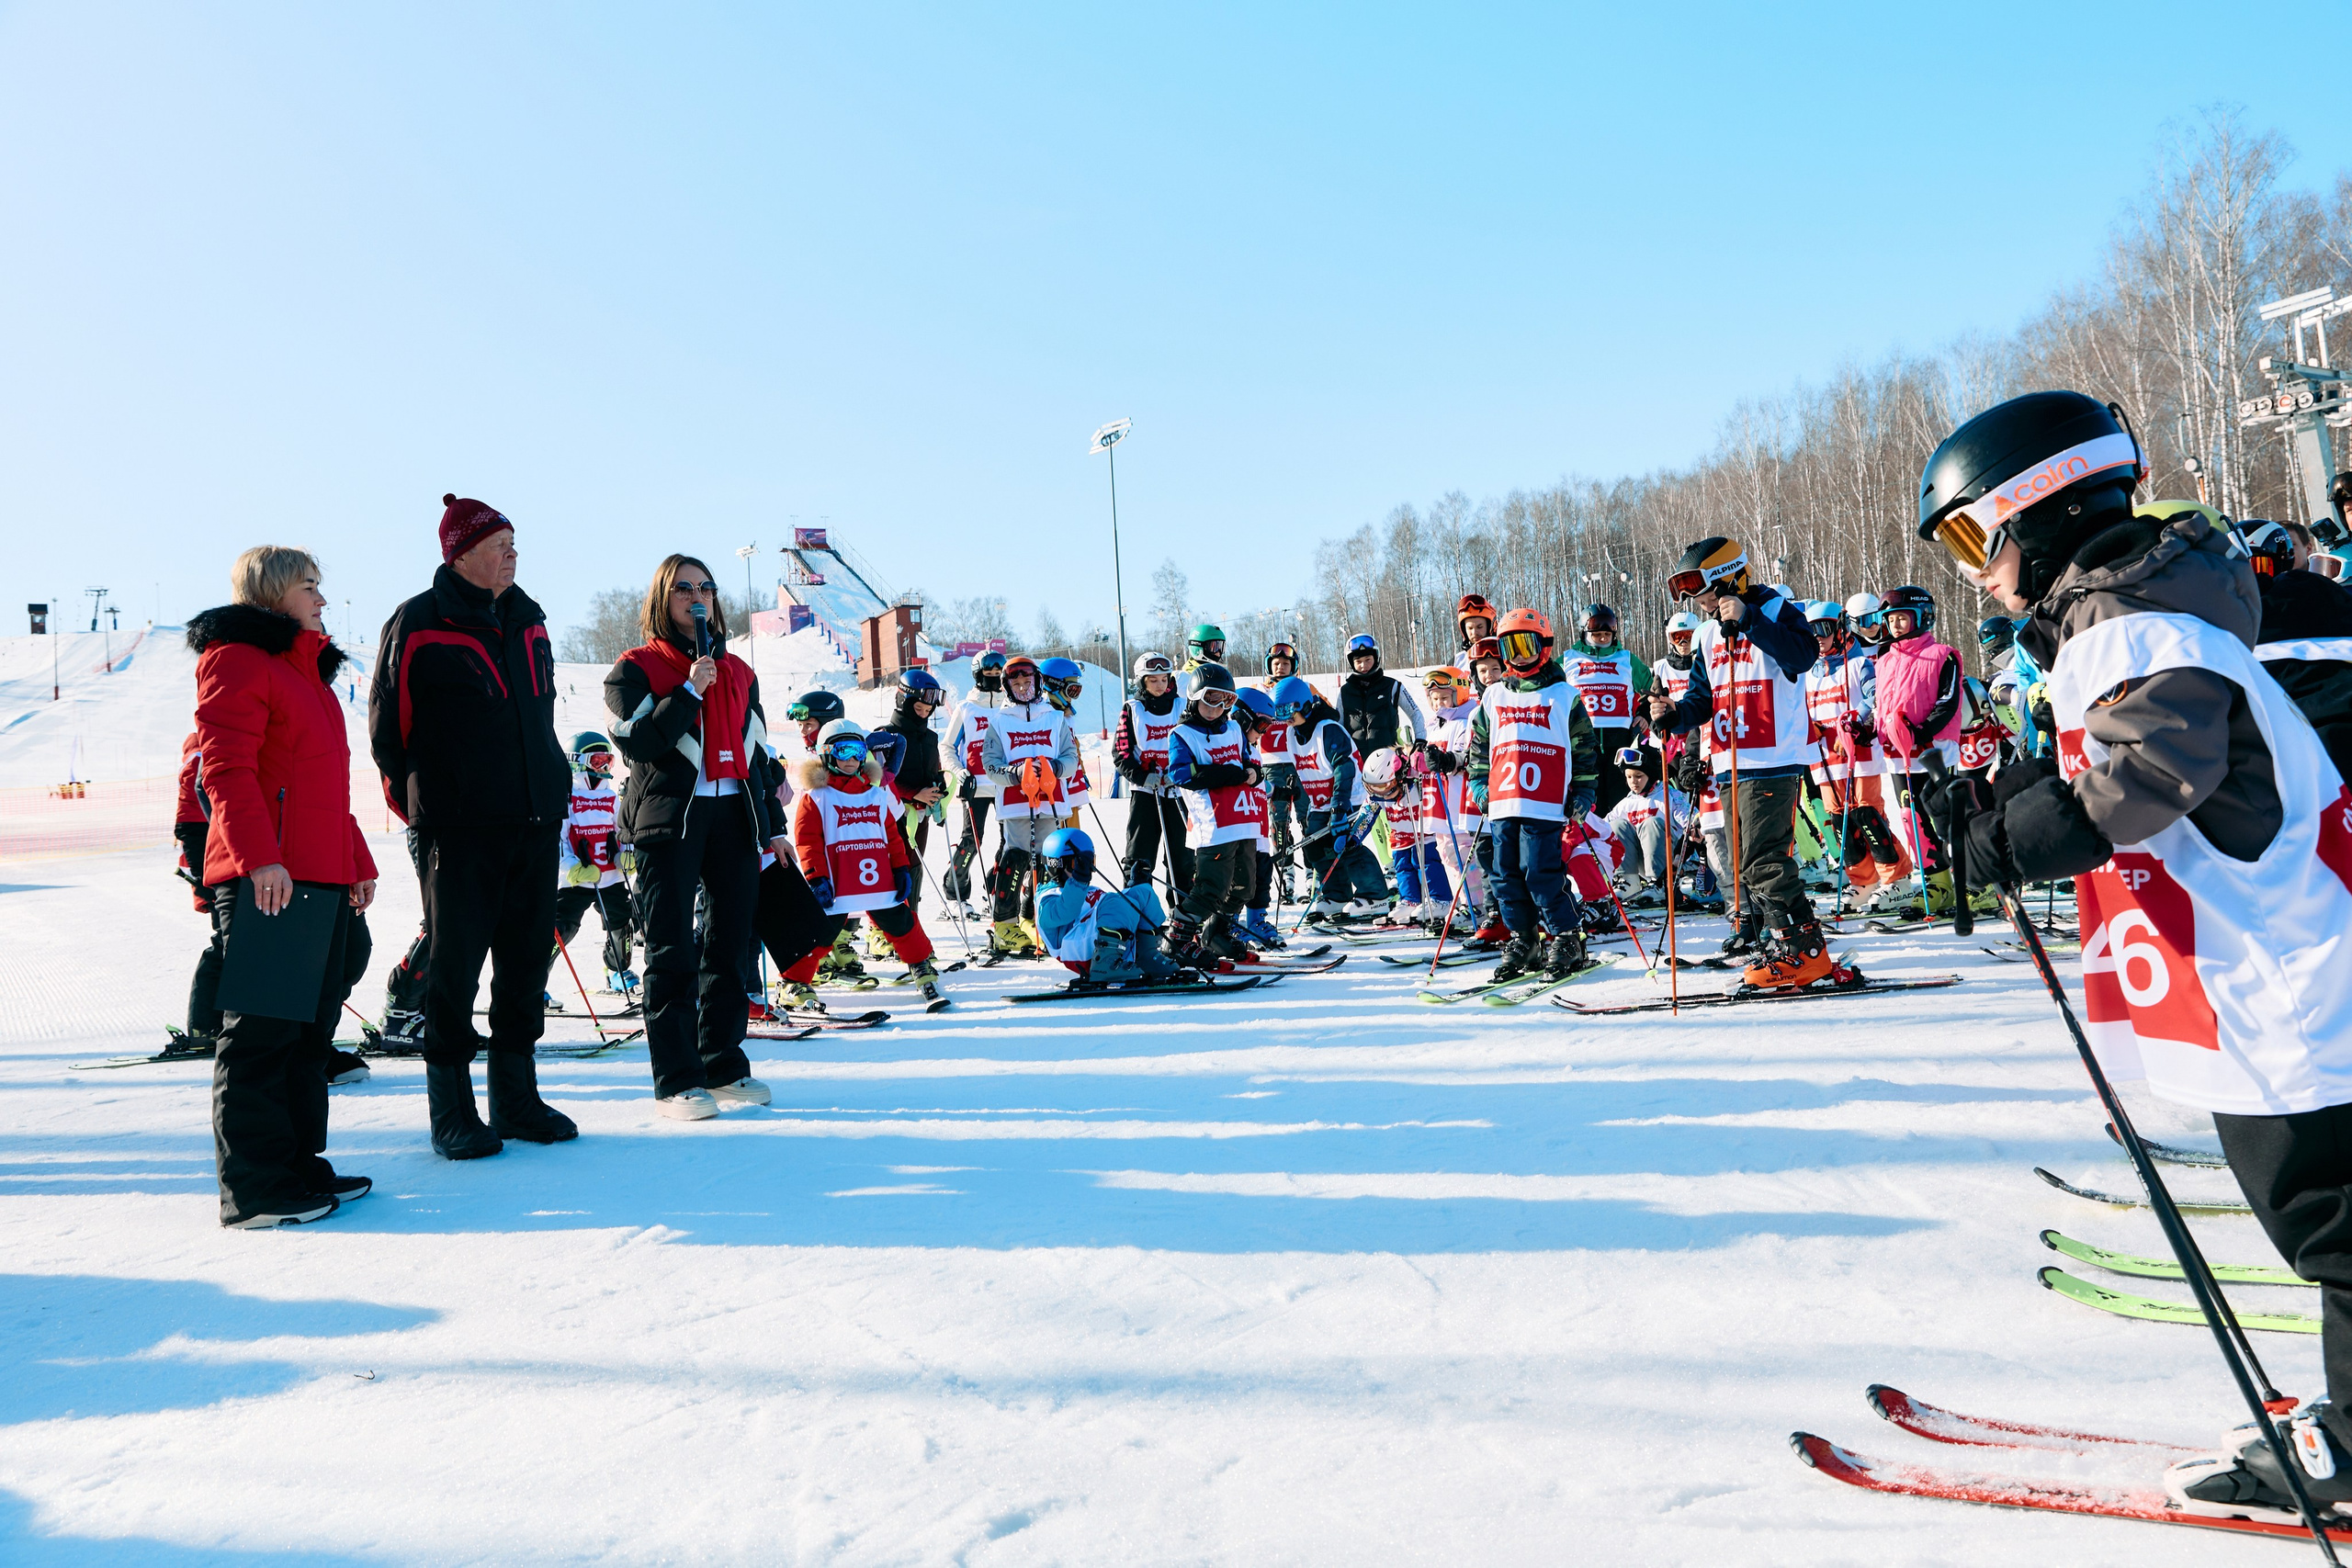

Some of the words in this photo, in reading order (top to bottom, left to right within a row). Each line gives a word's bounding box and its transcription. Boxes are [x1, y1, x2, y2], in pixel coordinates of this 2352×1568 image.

[2014, 457, 2089, 502] cairn
[1709, 560, 1744, 578] ALPINA
[1736, 684, 1763, 694] НОМЕР
[1584, 694, 1616, 713] 89
[1500, 711, 1525, 721] Альфа
[1526, 711, 1544, 719] Банк
[1713, 705, 1749, 742] 64
[1014, 734, 1033, 743] Альфа
[565, 752, 582, 763] LIZ
[1530, 745, 1557, 756] НОМЕР
[1961, 738, 1996, 764] 86
[1498, 761, 1542, 792] 20
[576, 798, 597, 809] Альфа
[1233, 790, 1259, 817] 44
[842, 810, 862, 820] Альфа
[1861, 824, 1879, 846] LEKI
[594, 842, 608, 865] 5
[858, 858, 880, 886] 8
[1010, 870, 1021, 893] LEKI
[1889, 891, 1914, 904] HEAD
[2082, 908, 2170, 1008] 46
[382, 1034, 413, 1043] HEAD
